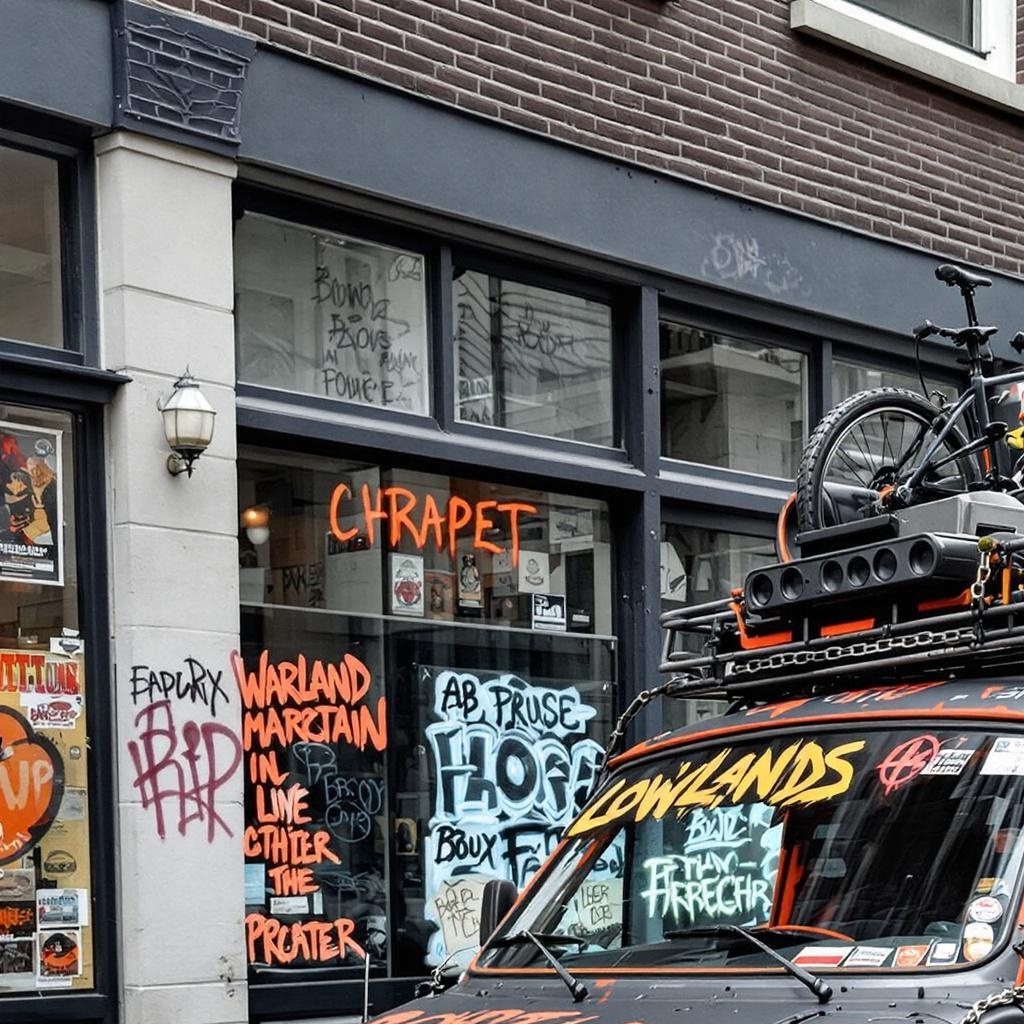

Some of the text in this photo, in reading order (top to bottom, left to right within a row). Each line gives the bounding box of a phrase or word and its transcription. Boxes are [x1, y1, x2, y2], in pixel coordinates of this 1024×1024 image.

[329, 482, 538, 568] CHRAPET
[233, 649, 371, 709] WARLAND
[250, 750, 290, 784] IN
[562, 738, 866, 838] LOWLANDS
[268, 865, 320, 896] THE
